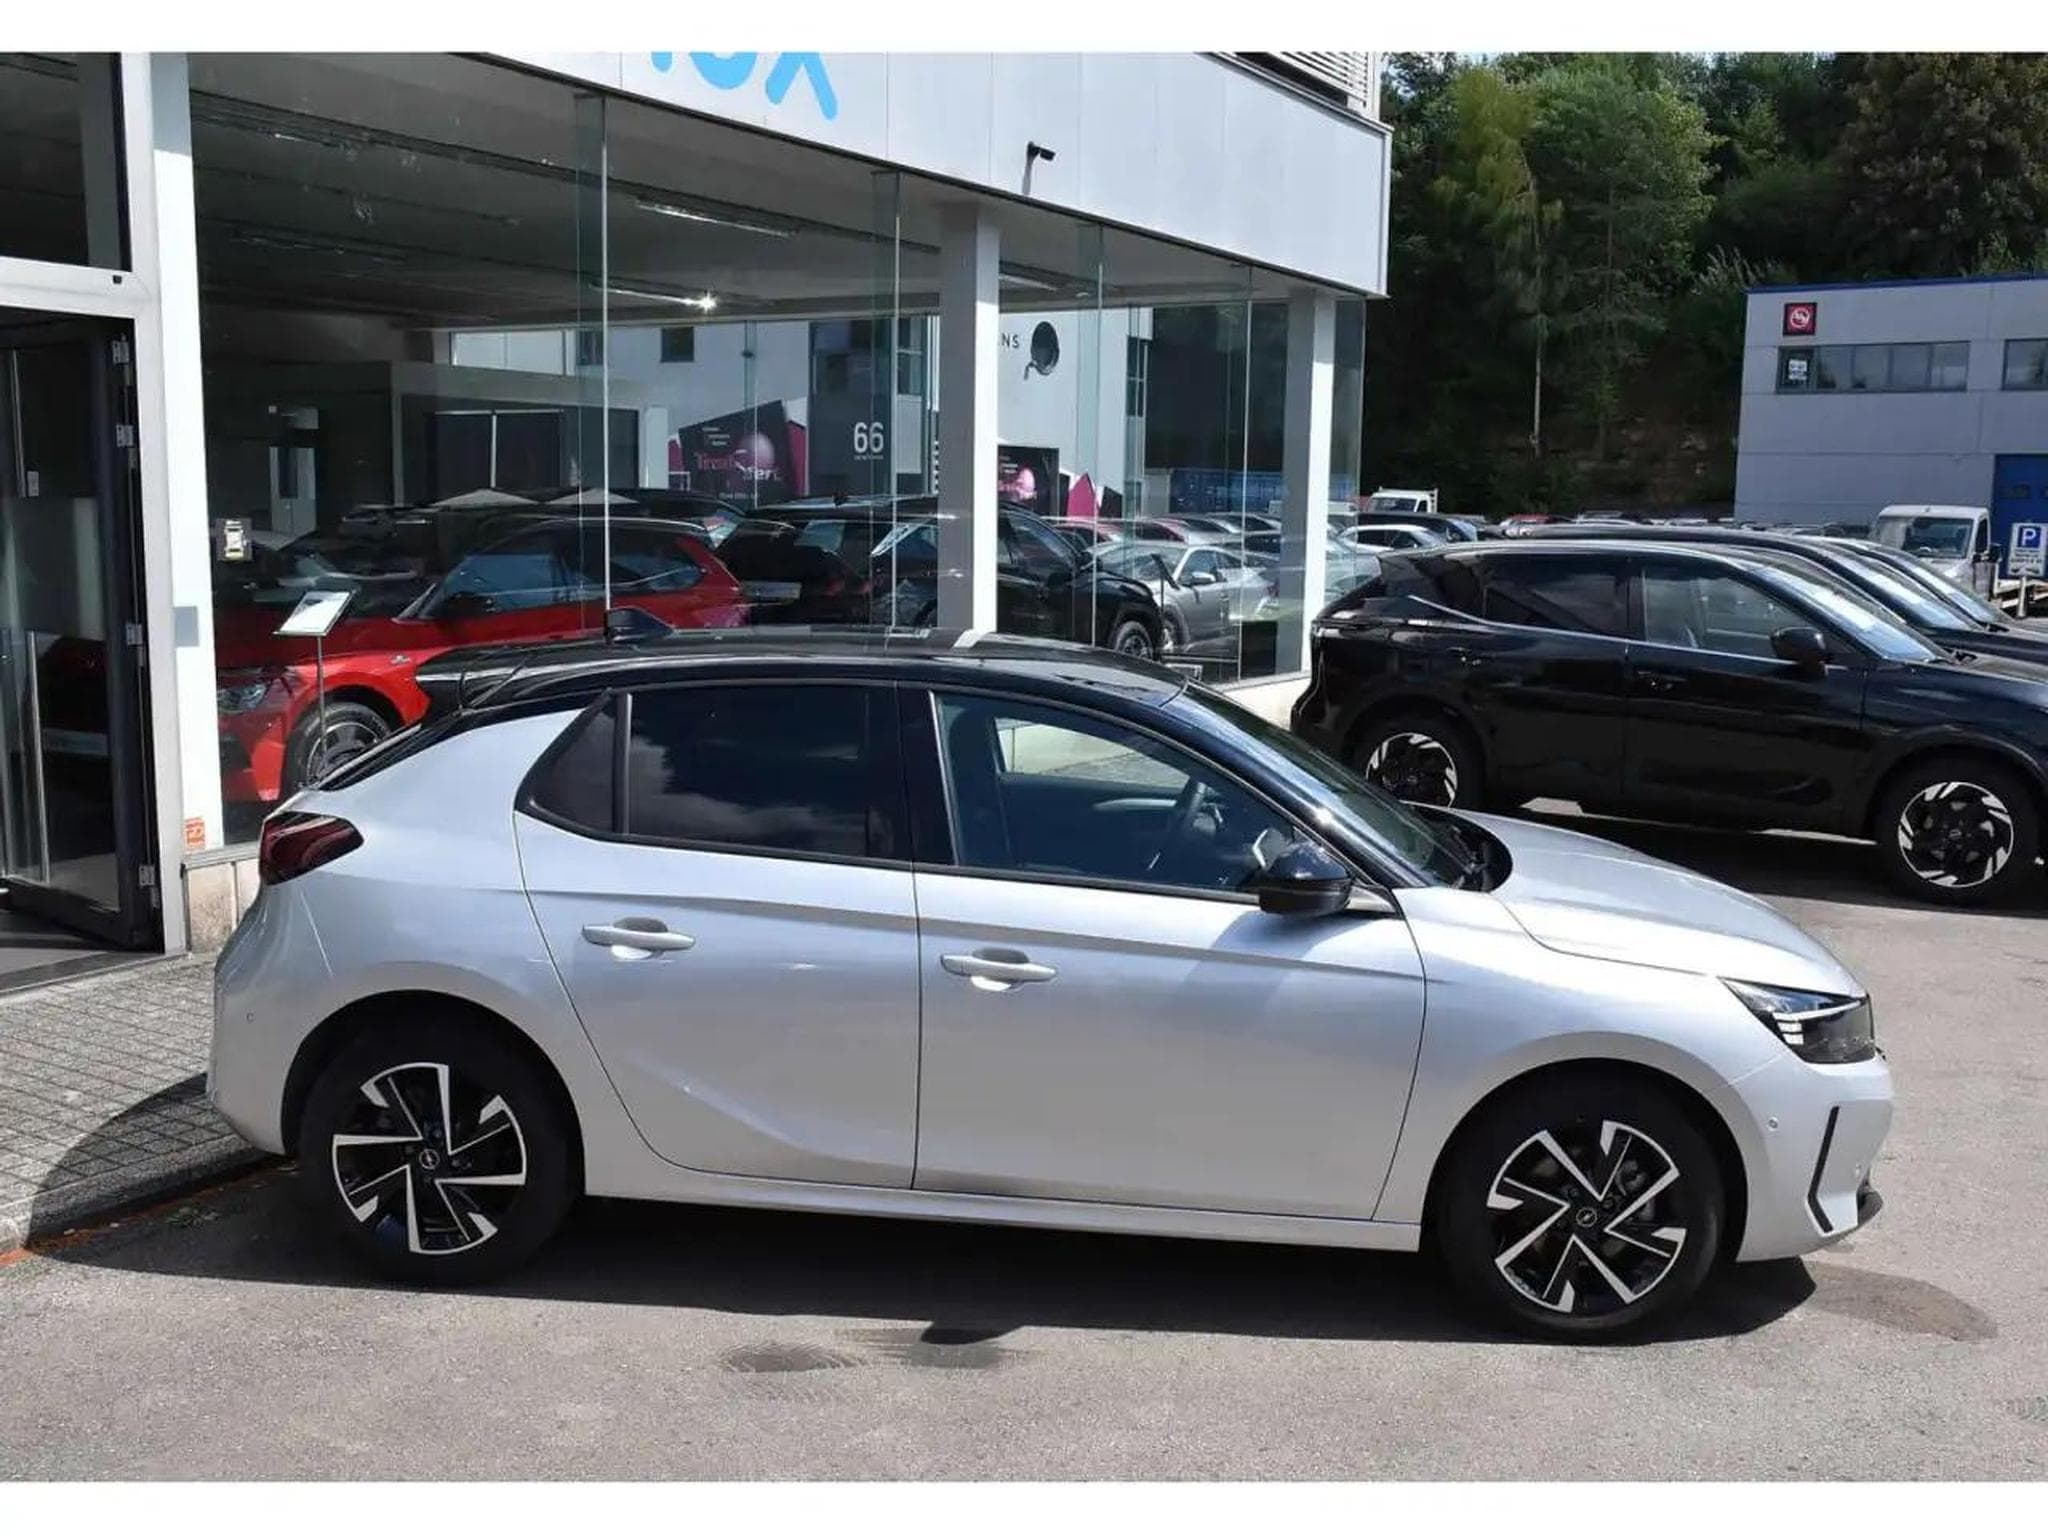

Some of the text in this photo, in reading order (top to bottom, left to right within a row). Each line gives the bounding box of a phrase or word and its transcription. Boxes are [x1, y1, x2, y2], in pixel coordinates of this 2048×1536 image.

[1000, 333, 1020, 349] NS
[854, 422, 884, 453] 66
[2022, 528, 2036, 545] P
